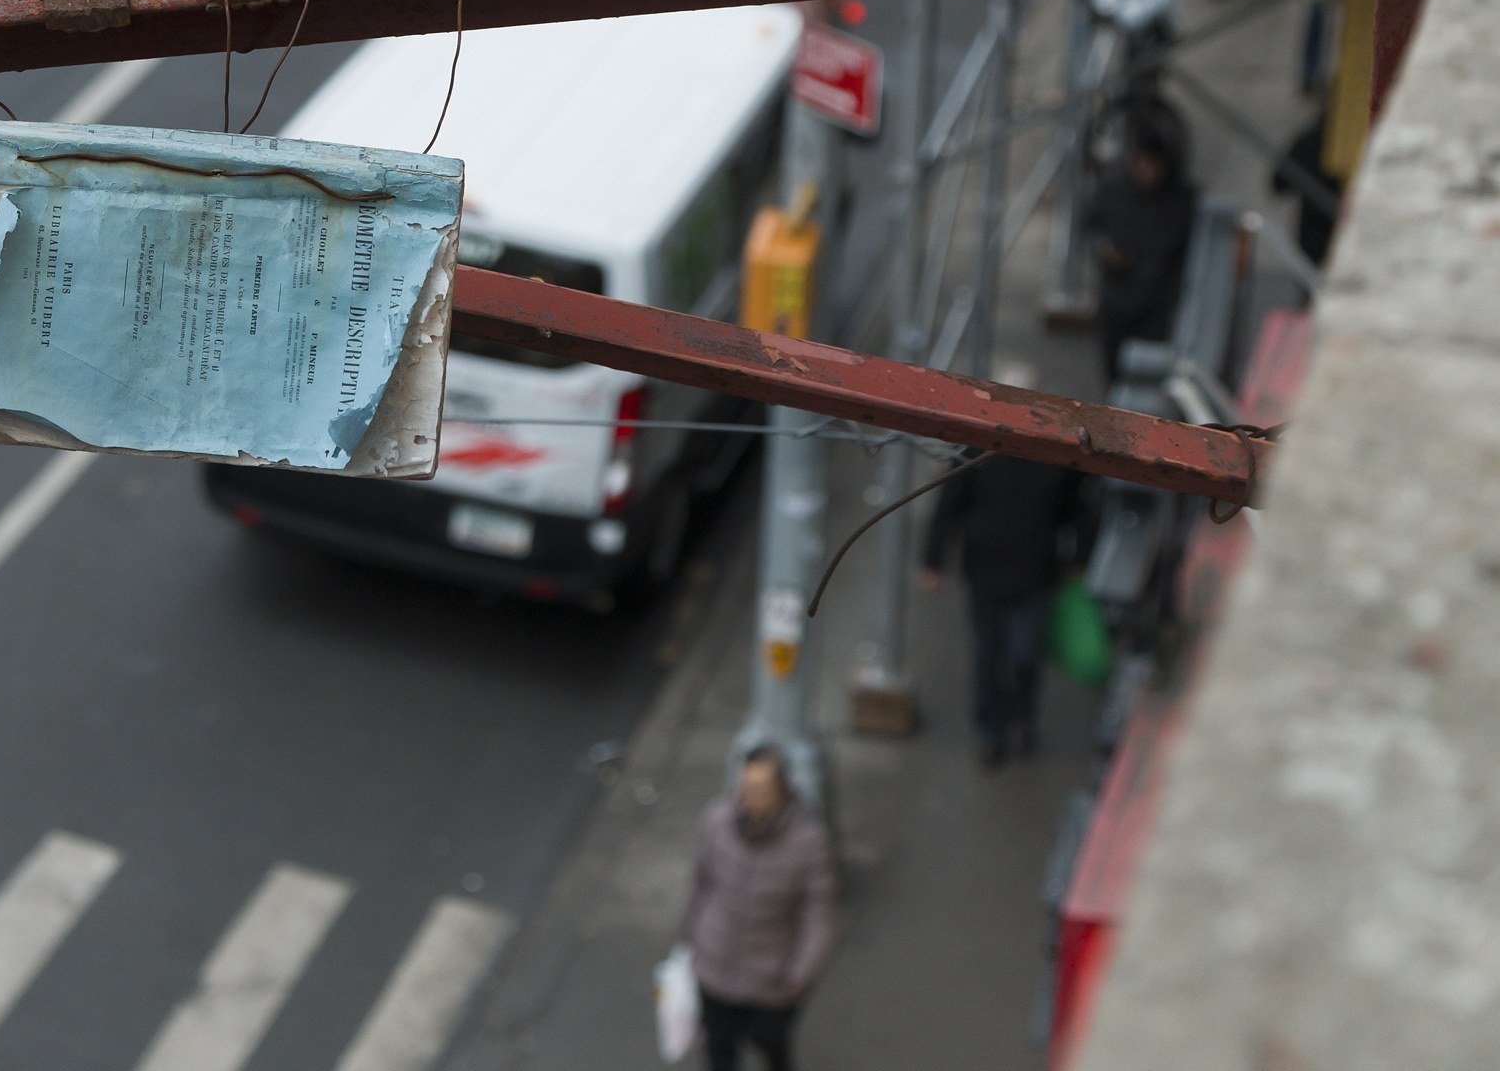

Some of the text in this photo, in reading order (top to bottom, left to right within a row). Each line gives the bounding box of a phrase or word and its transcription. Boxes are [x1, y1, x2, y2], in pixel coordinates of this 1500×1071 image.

[200, 211, 208, 221] des
[225, 212, 233, 230] DES
[321, 214, 328, 223] T.
[221, 233, 233, 267] ÉLÈVES
[316, 227, 327, 274] CHOLLET
[40, 205, 61, 347] LIBRAIRIE VUIBERT
[61, 262, 73, 293] PARIS
[141, 243, 154, 325] NEUVIÈME ÉDITION
[199, 199, 223, 381] ET DES CANDIDATS AU BACCALAURÉAT
[219, 271, 228, 284] DE
[389, 275, 404, 309] TRA
[183, 283, 191, 309] Institut
[249, 254, 262, 335] PREMIÈRE PARTIE
[215, 288, 226, 335] PREMIÈRE
[189, 314, 197, 346] candidats
[311, 332, 318, 340] P.
[213, 349, 221, 361] ET
[306, 344, 317, 384] MINEUR
